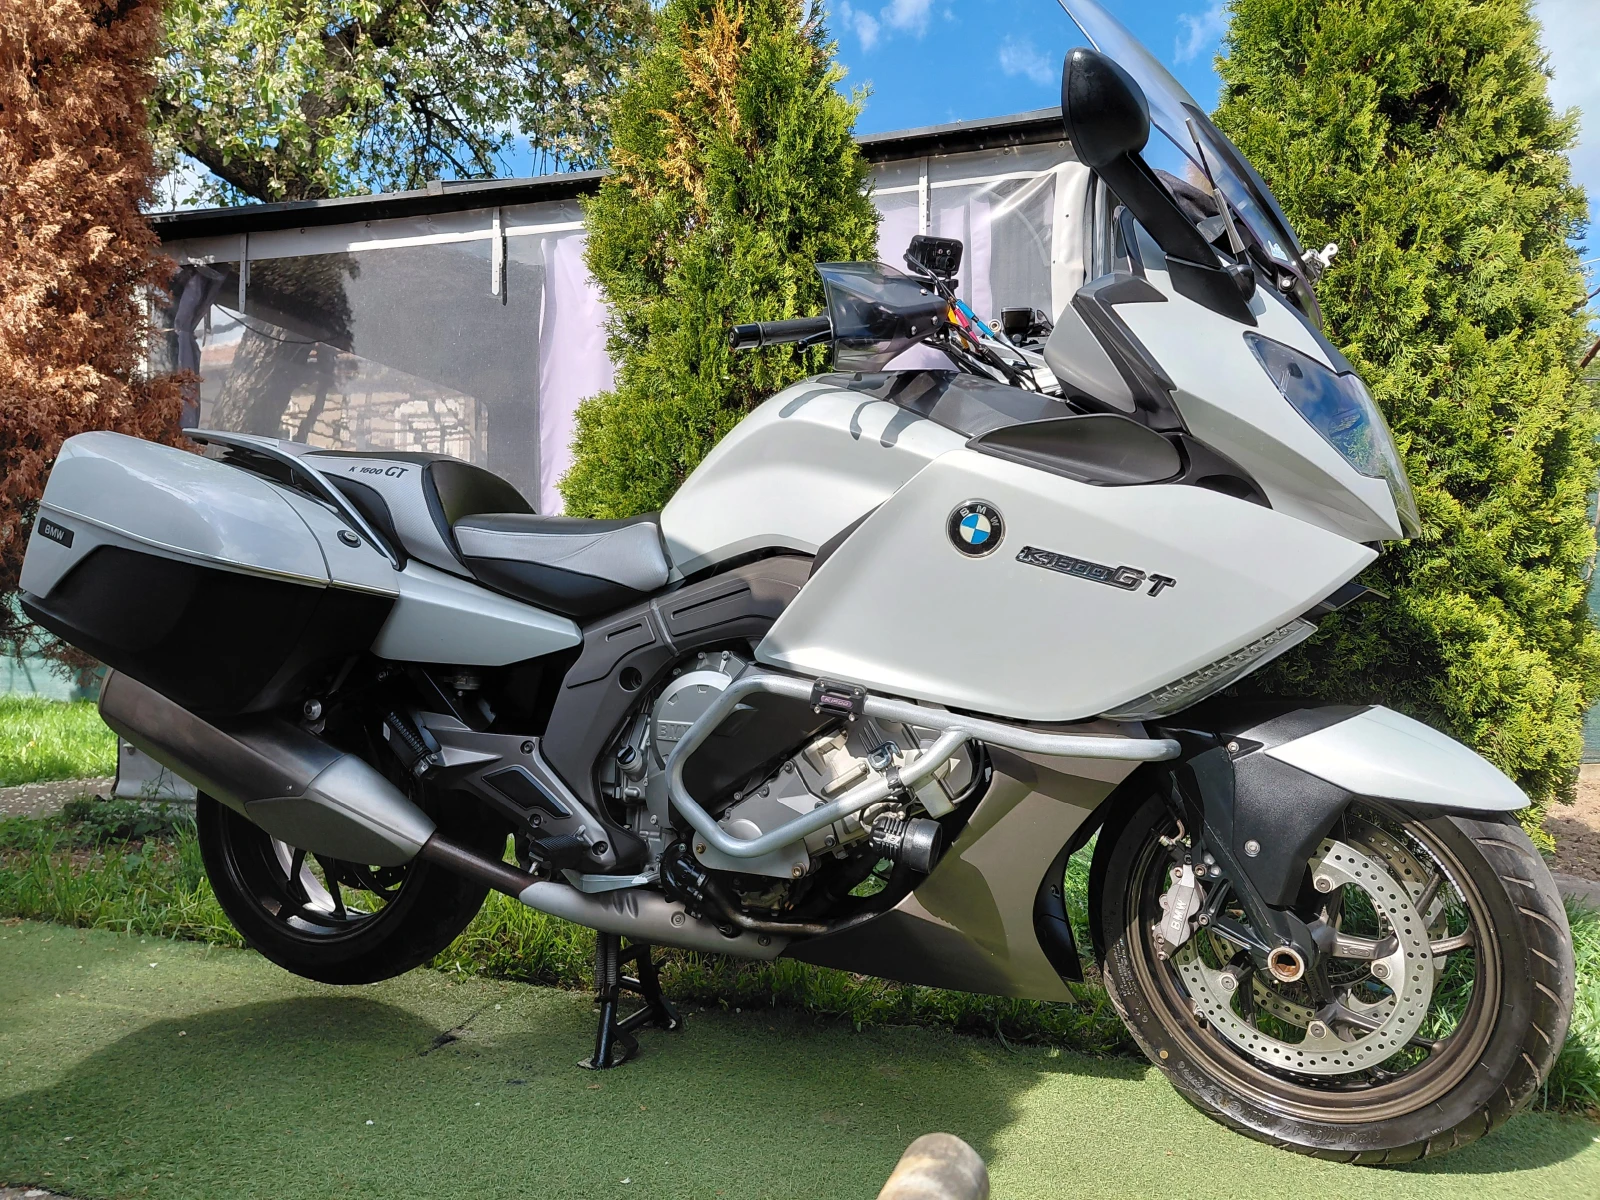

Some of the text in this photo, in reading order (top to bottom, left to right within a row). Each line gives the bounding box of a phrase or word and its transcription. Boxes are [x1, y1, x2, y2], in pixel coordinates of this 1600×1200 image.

[385, 466, 409, 479] GT
[960, 504, 1000, 527] BMW
[44, 523, 65, 541] BMW
[1170, 898, 1188, 931] BMW
